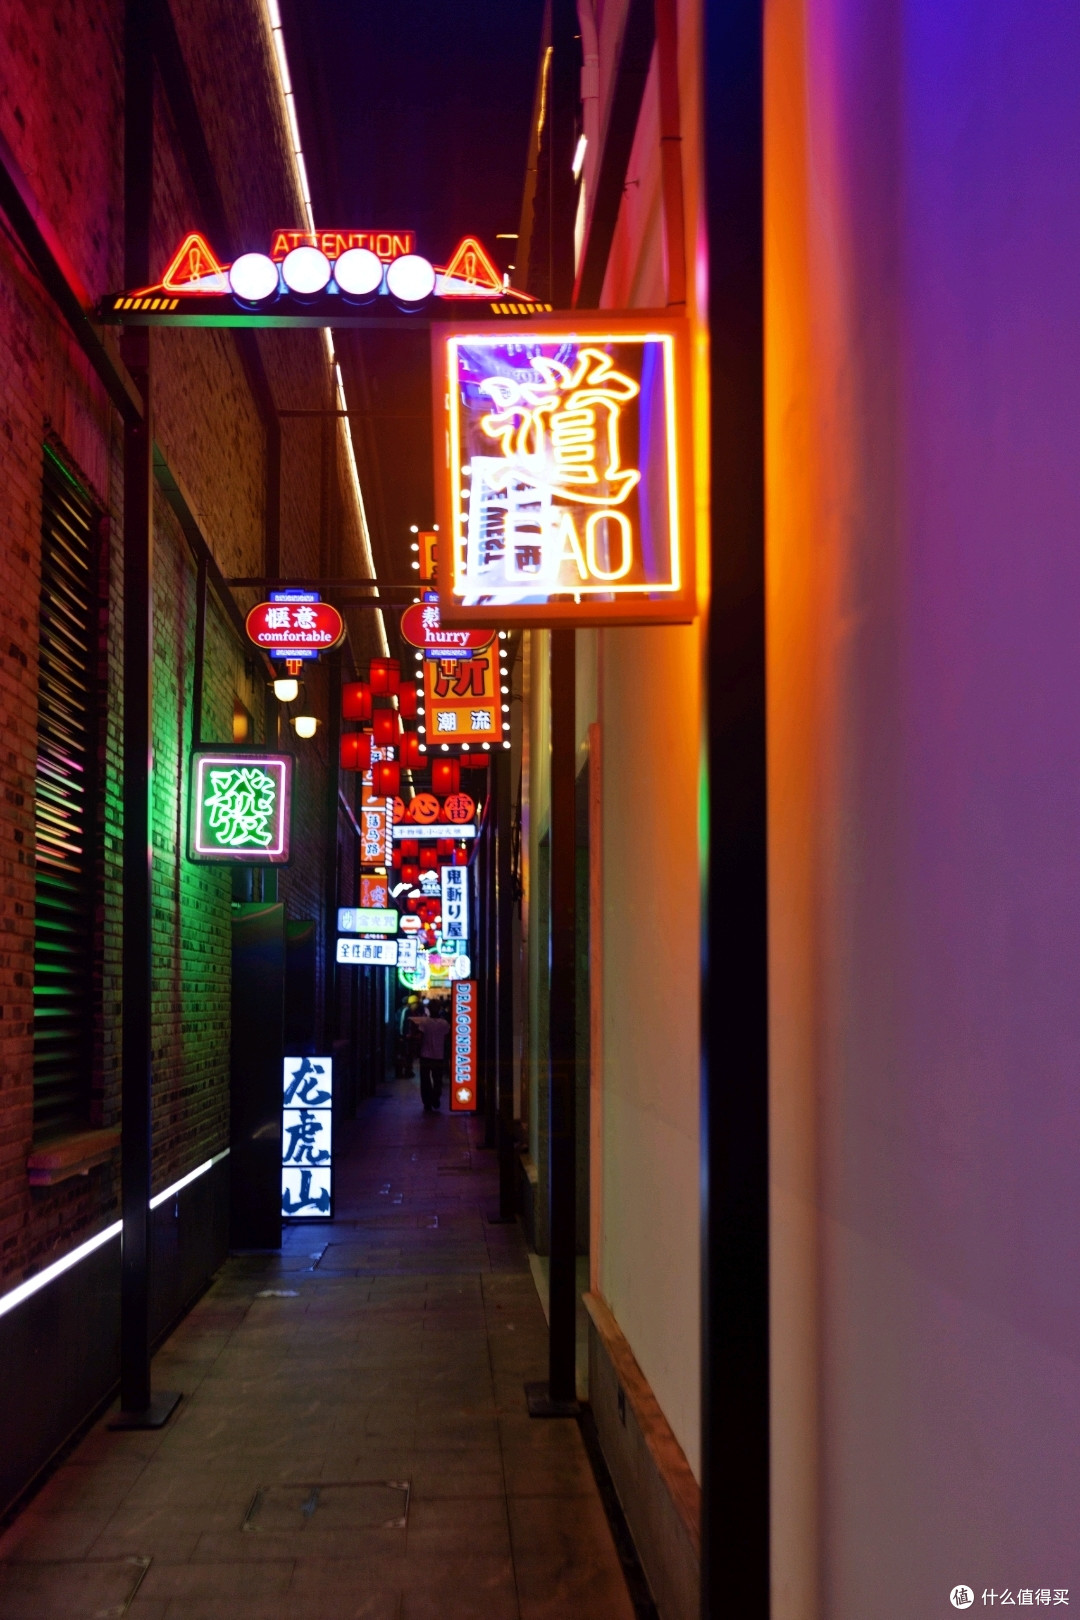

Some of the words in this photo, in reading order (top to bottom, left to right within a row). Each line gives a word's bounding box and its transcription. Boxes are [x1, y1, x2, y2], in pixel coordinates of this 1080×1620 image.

[273, 233, 412, 259] ATTENTION
[480, 347, 640, 505] 道
[257, 630, 332, 642] comfortable
[424, 628, 471, 647] hurry
[437, 710, 491, 732] 潮流
[446, 869, 463, 937] 鬼斬り屋
[455, 983, 472, 1083] DRAGONBALL
[282, 1057, 332, 1213] 龙虎山
